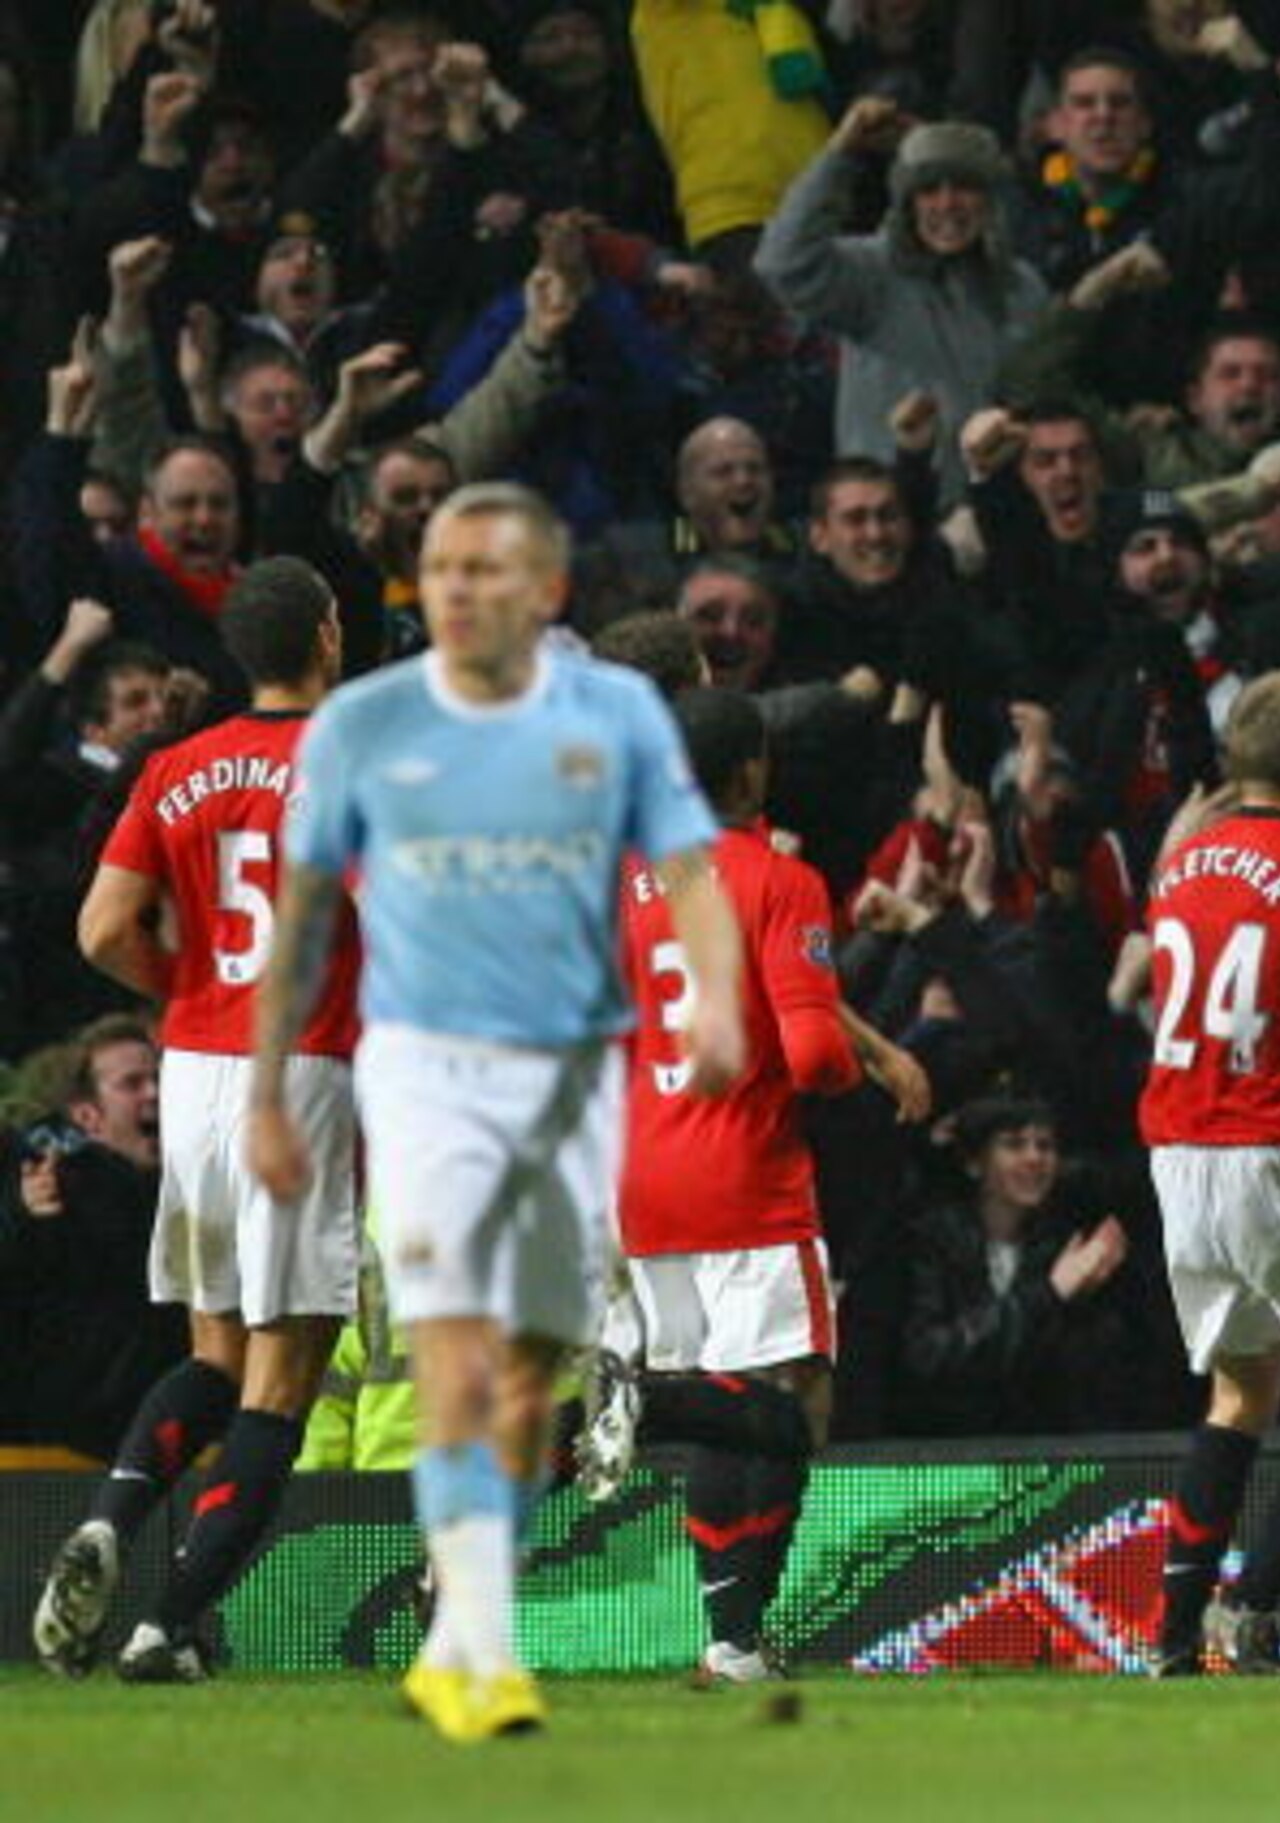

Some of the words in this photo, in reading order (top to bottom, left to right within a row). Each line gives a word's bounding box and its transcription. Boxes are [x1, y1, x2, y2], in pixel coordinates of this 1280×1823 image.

[156, 756, 297, 827] FERDINA
[213, 829, 275, 985] 5
[651, 941, 698, 1095] 3
[1153, 916, 1270, 1074] 24
